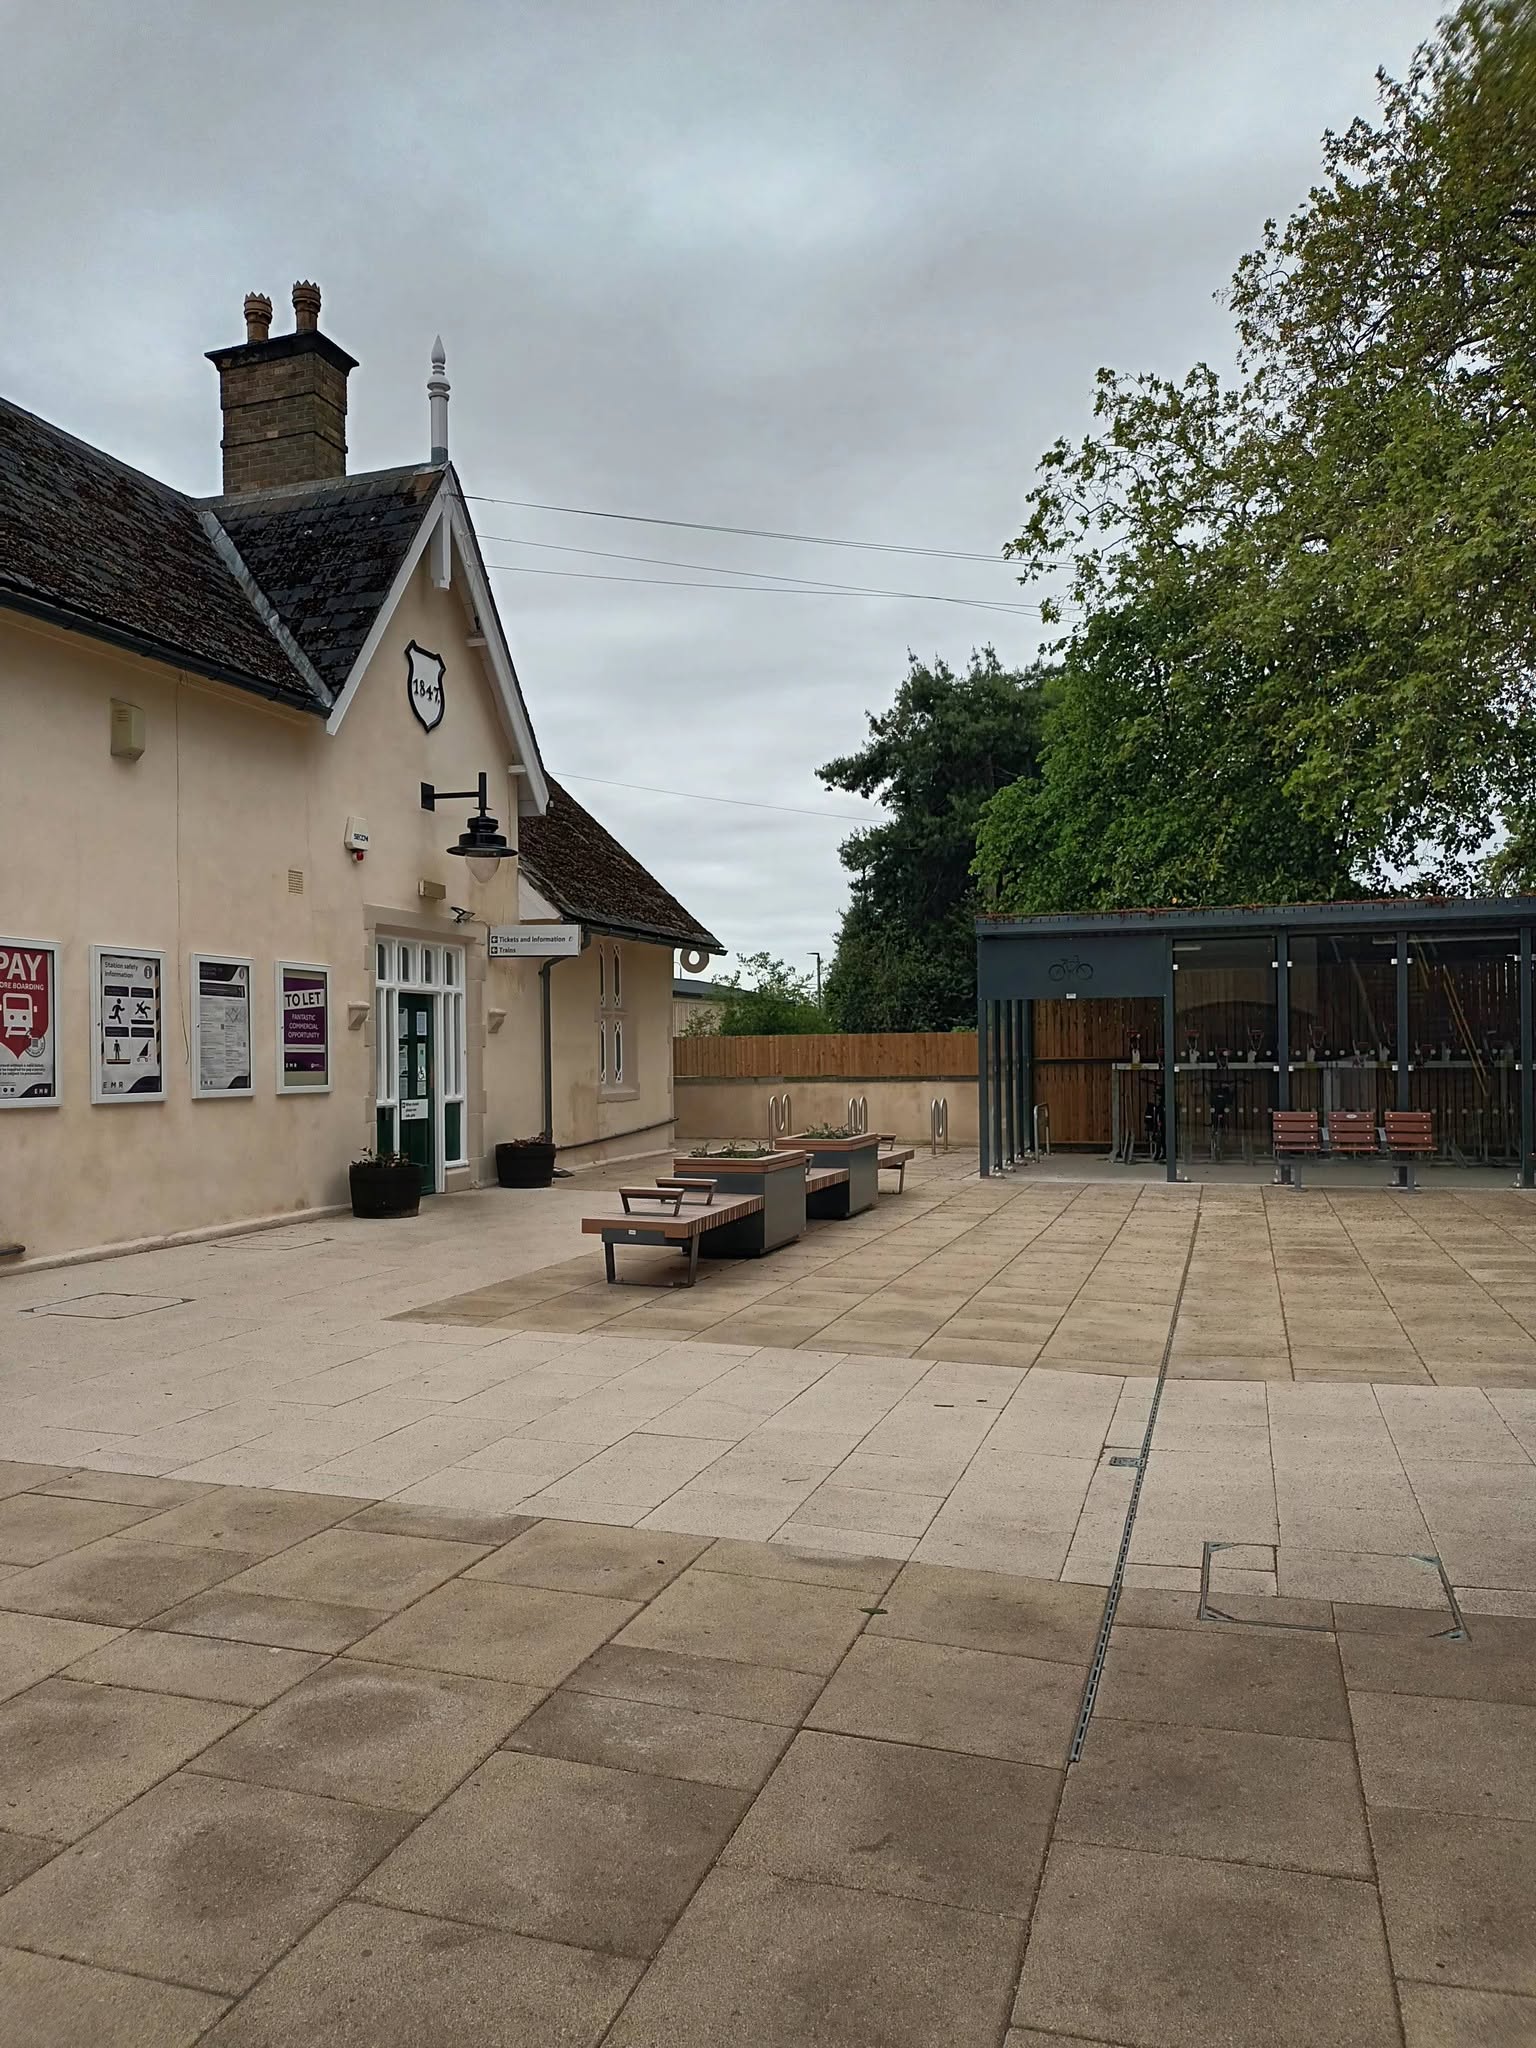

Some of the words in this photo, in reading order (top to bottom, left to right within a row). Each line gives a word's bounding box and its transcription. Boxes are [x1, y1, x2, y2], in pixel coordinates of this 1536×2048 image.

[532, 935, 566, 943] Information
[105, 961, 123, 969] Station
[124, 963, 139, 971] safety
[12, 983, 45, 991] BOARDING
[285, 993, 300, 1008] TO
[302, 992, 321, 1006] LET
[291, 1013, 316, 1021] FANTASTIC
[289, 1022, 319, 1030] COMMERCIAL
[287, 1031, 320, 1039] OPPORTUNITY
